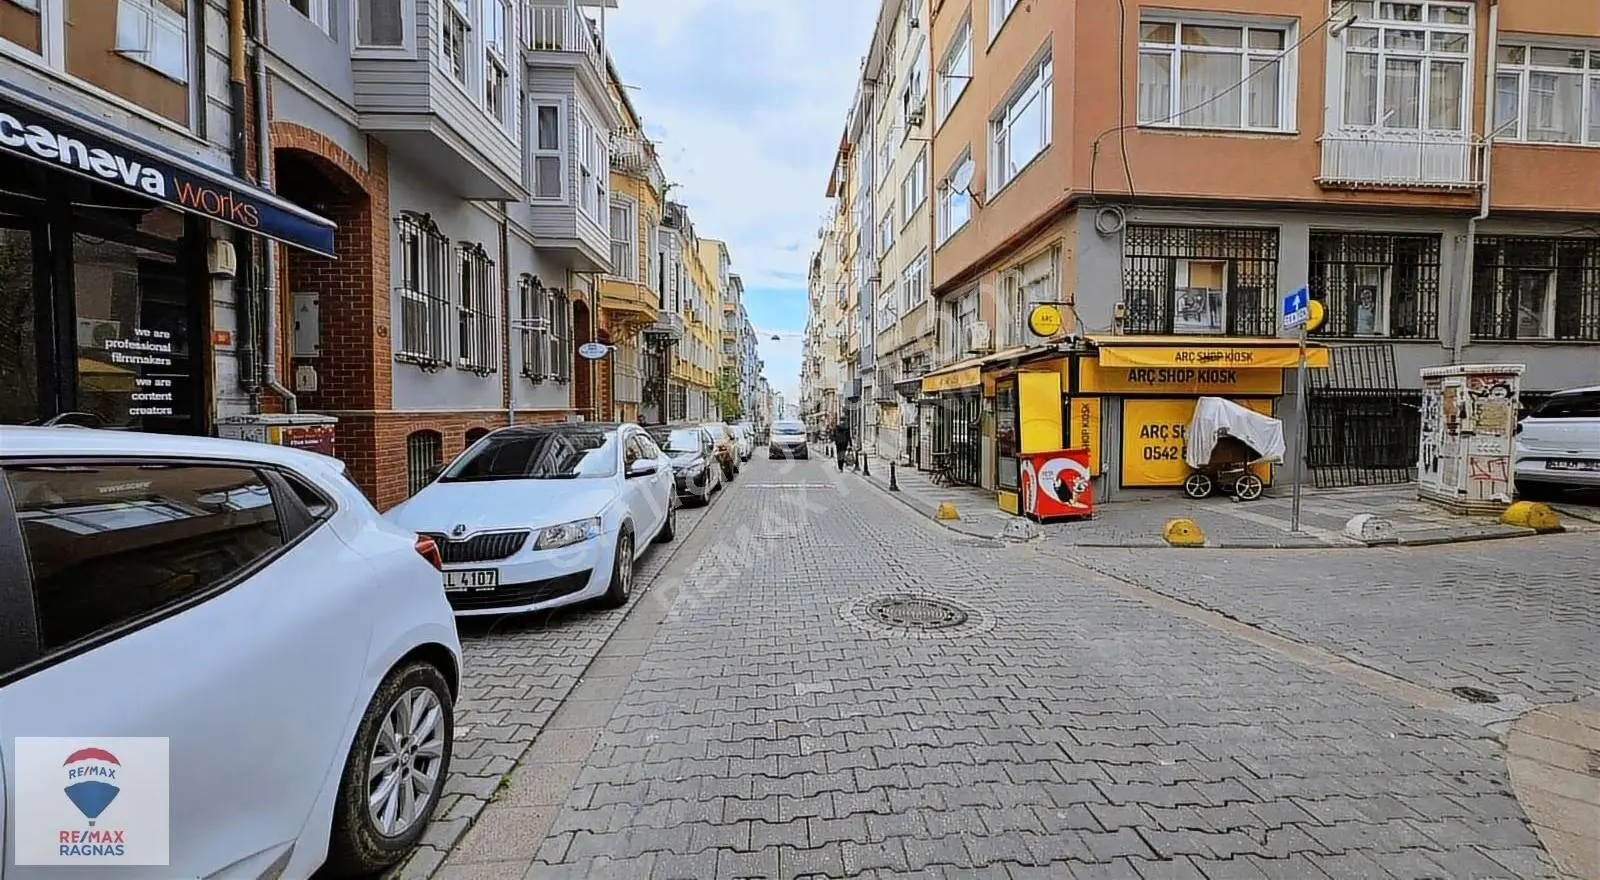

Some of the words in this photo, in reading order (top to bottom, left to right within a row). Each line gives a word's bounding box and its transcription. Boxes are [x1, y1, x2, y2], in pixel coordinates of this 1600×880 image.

[0, 112, 165, 197] ceneva
[173, 171, 259, 227] works
[134, 328, 151, 337] we
[153, 330, 171, 338] are
[104, 339, 171, 352] professional
[111, 352, 172, 366] filmmakers
[1174, 351, 1196, 364] ARÇ
[1197, 351, 1224, 363] SHOP
[135, 378, 152, 386] we
[154, 379, 172, 387] are
[1128, 368, 1157, 386] ARÇ
[1158, 369, 1195, 383] SHOP
[1197, 368, 1237, 384] KIOSK
[131, 392, 173, 401] content
[129, 406, 173, 415] creators
[1080, 402, 1090, 428] KIOSK
[1139, 424, 1168, 443] ARÇ
[1143, 446, 1179, 460] 0542
[461, 571, 495, 586] 4107
